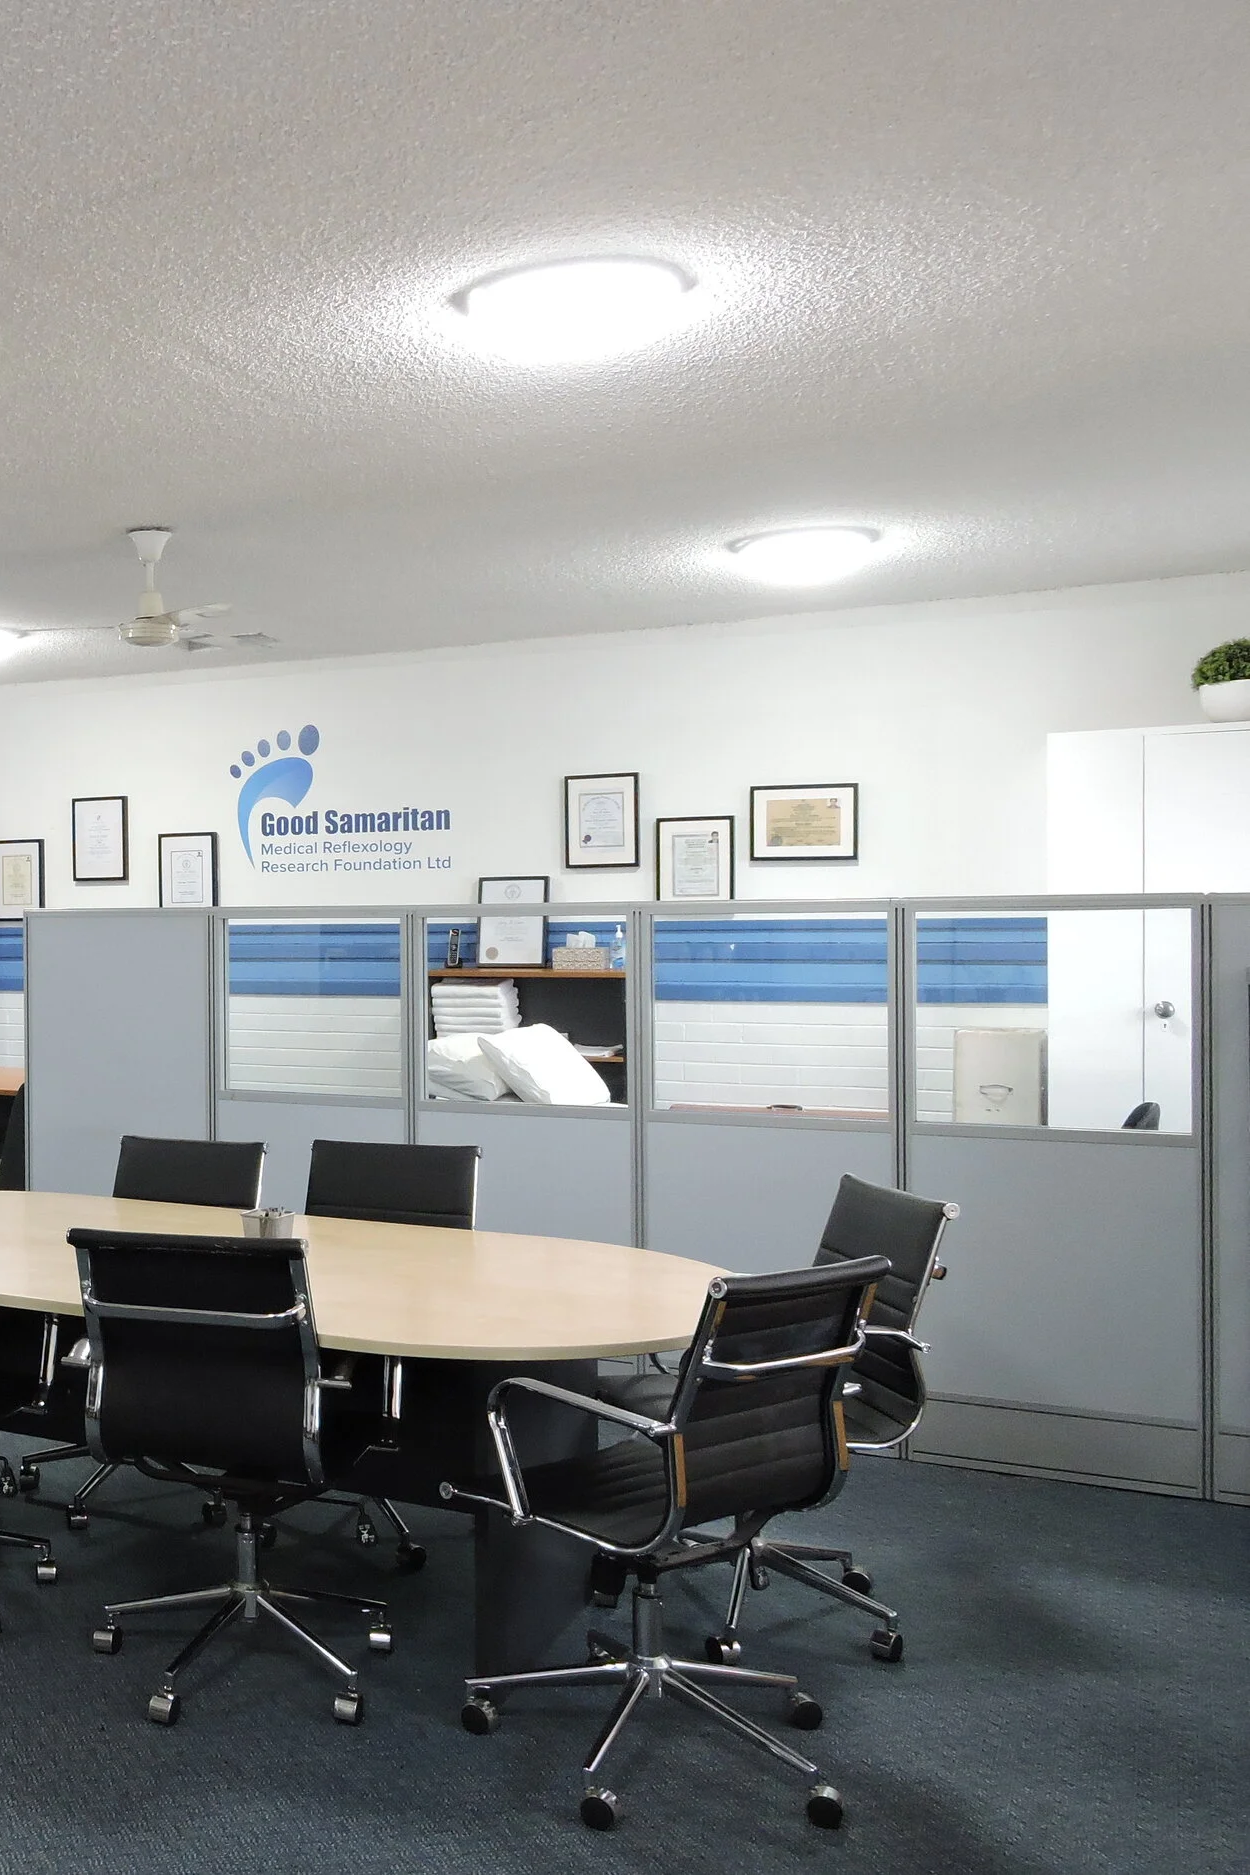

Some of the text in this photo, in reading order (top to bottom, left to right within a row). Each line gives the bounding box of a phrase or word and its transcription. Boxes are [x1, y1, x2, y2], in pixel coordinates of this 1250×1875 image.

[260, 807, 451, 837] Good Samaritan
[261, 840, 413, 855] Medical Reflexology
[261, 856, 452, 873] Research Foundation Ltd
